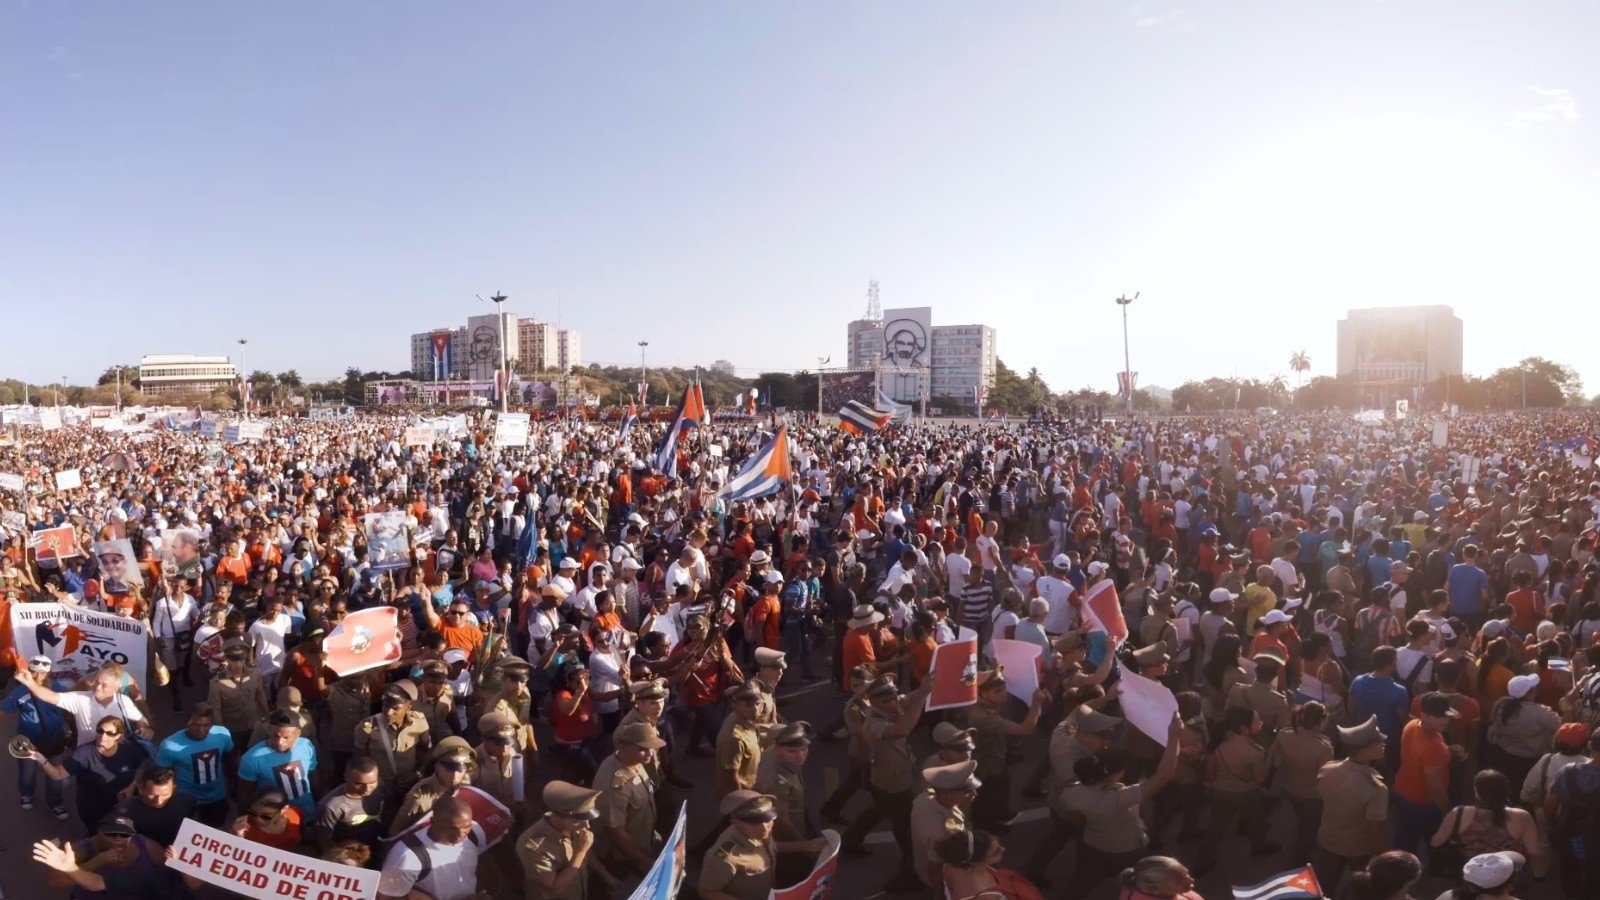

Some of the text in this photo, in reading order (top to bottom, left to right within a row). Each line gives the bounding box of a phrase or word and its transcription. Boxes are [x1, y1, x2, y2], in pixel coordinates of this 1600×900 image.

[74, 614, 85, 623] DE
[86, 616, 142, 635] SOLIDARIDAD
[178, 847, 203, 868] LA
[209, 858, 269, 889] EDAD
[276, 879, 309, 900] DE
[191, 833, 363, 893] CIRCULO INFANTIL
